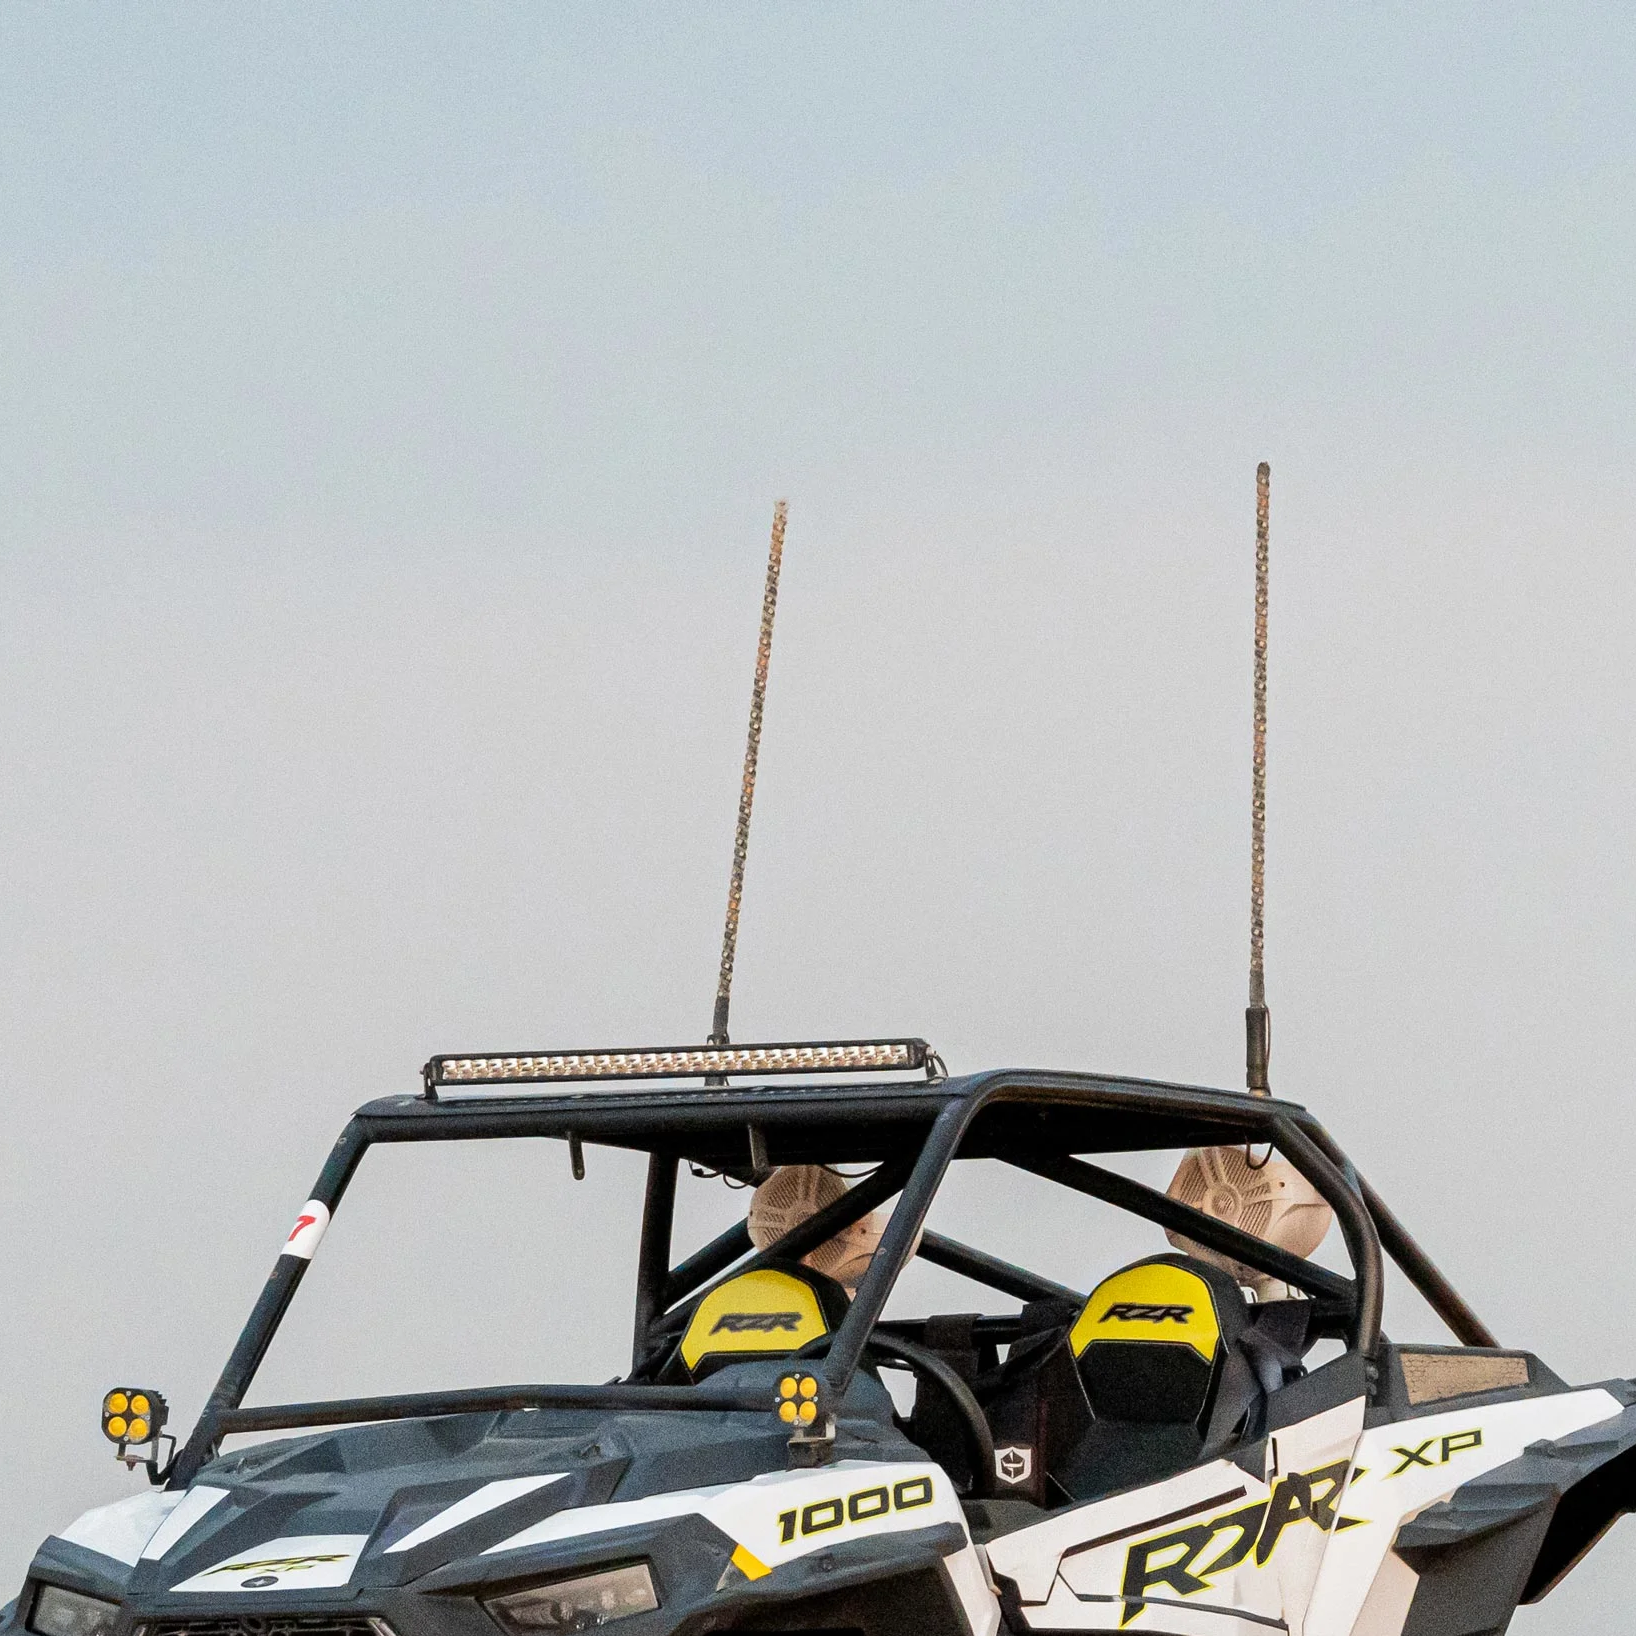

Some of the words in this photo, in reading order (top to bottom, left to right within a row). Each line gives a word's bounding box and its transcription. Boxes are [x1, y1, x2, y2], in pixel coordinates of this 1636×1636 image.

[709, 1312, 802, 1336] RZR
[1098, 1303, 1194, 1323] RZR
[1384, 1428, 1483, 1479] XP
[778, 1475, 933, 1545] 1000
